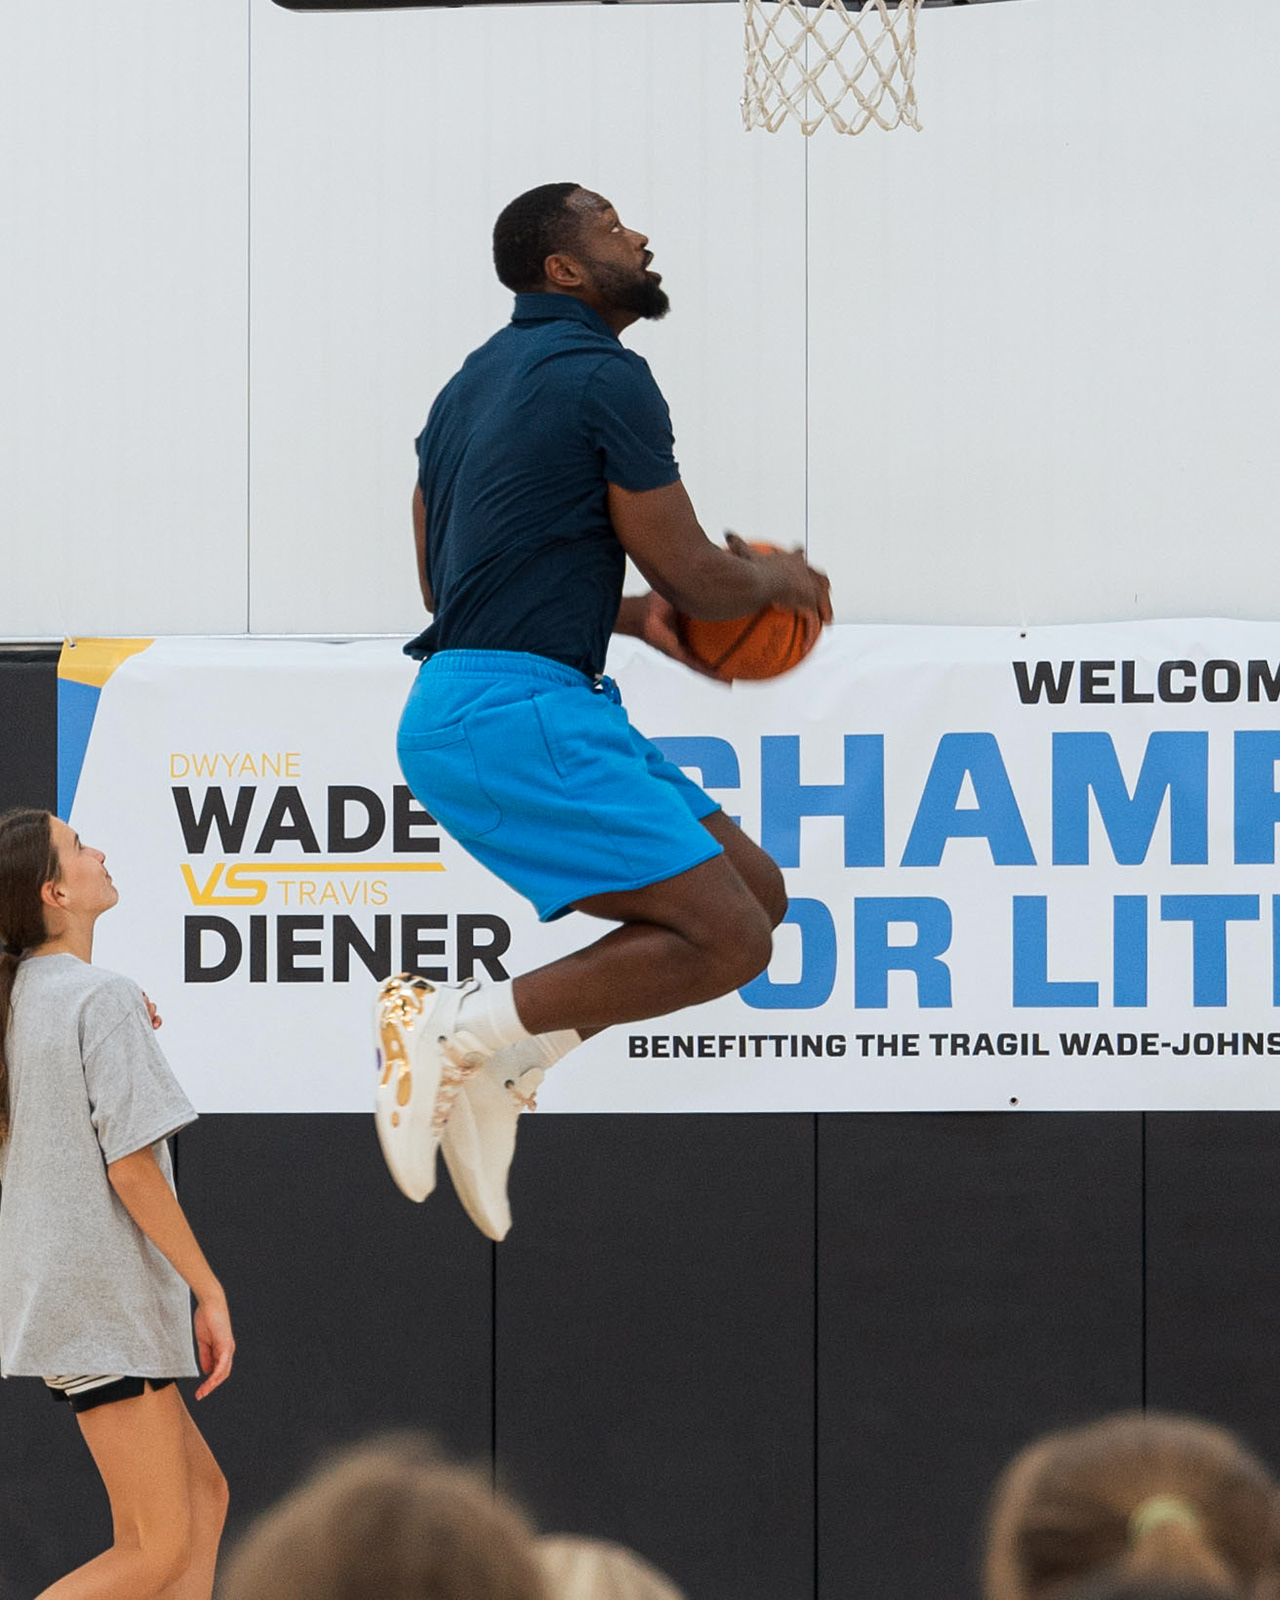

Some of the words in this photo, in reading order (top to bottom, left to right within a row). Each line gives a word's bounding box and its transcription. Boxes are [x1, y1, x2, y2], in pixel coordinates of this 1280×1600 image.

[170, 752, 301, 778] DWYANE
[172, 785, 441, 854] WADE
[180, 862, 268, 906] VS
[277, 880, 389, 906] TRAVIS
[184, 914, 511, 983] DIENER
[737, 897, 953, 1010] OR
[628, 1034, 847, 1058] BENEFITTING
[856, 1034, 920, 1057] THE
[929, 1033, 1050, 1056] TRAGIL
